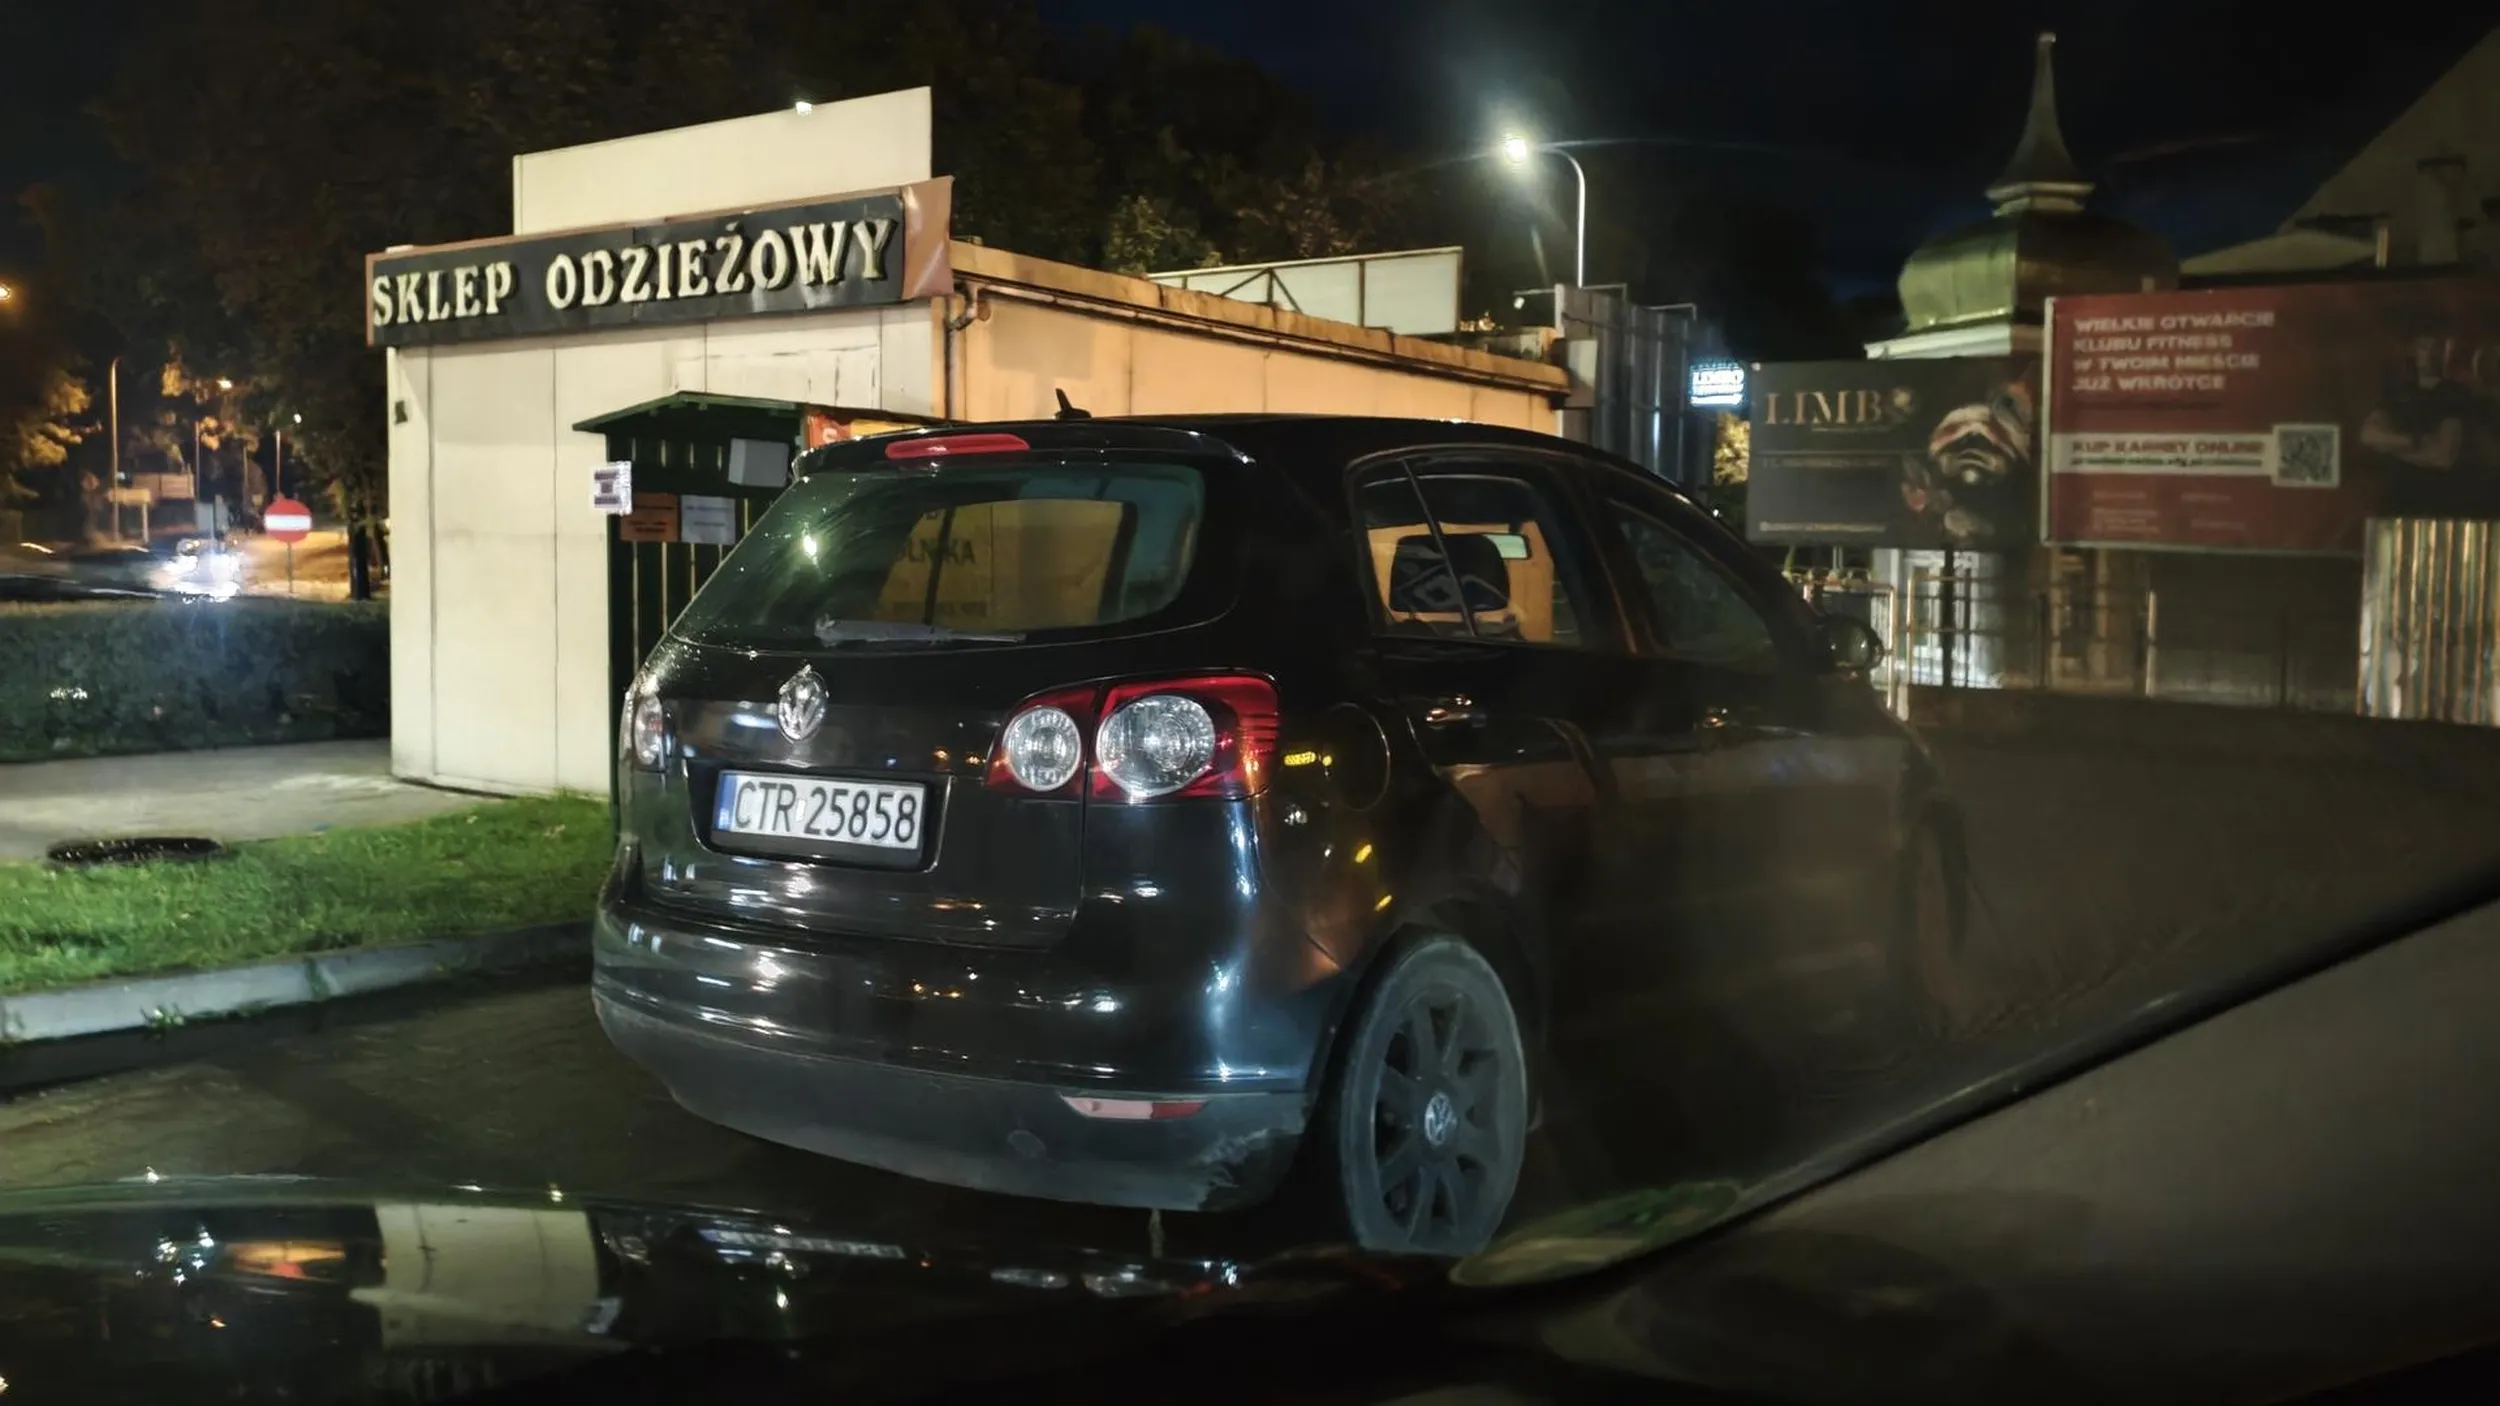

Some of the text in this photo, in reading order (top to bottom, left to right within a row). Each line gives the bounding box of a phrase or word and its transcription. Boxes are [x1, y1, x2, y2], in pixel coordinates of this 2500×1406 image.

[373, 219, 892, 327] SKLEP ODZIEŻOWY
[2146, 334, 2233, 350] FITNESS
[735, 780, 918, 843] CTR 25858
